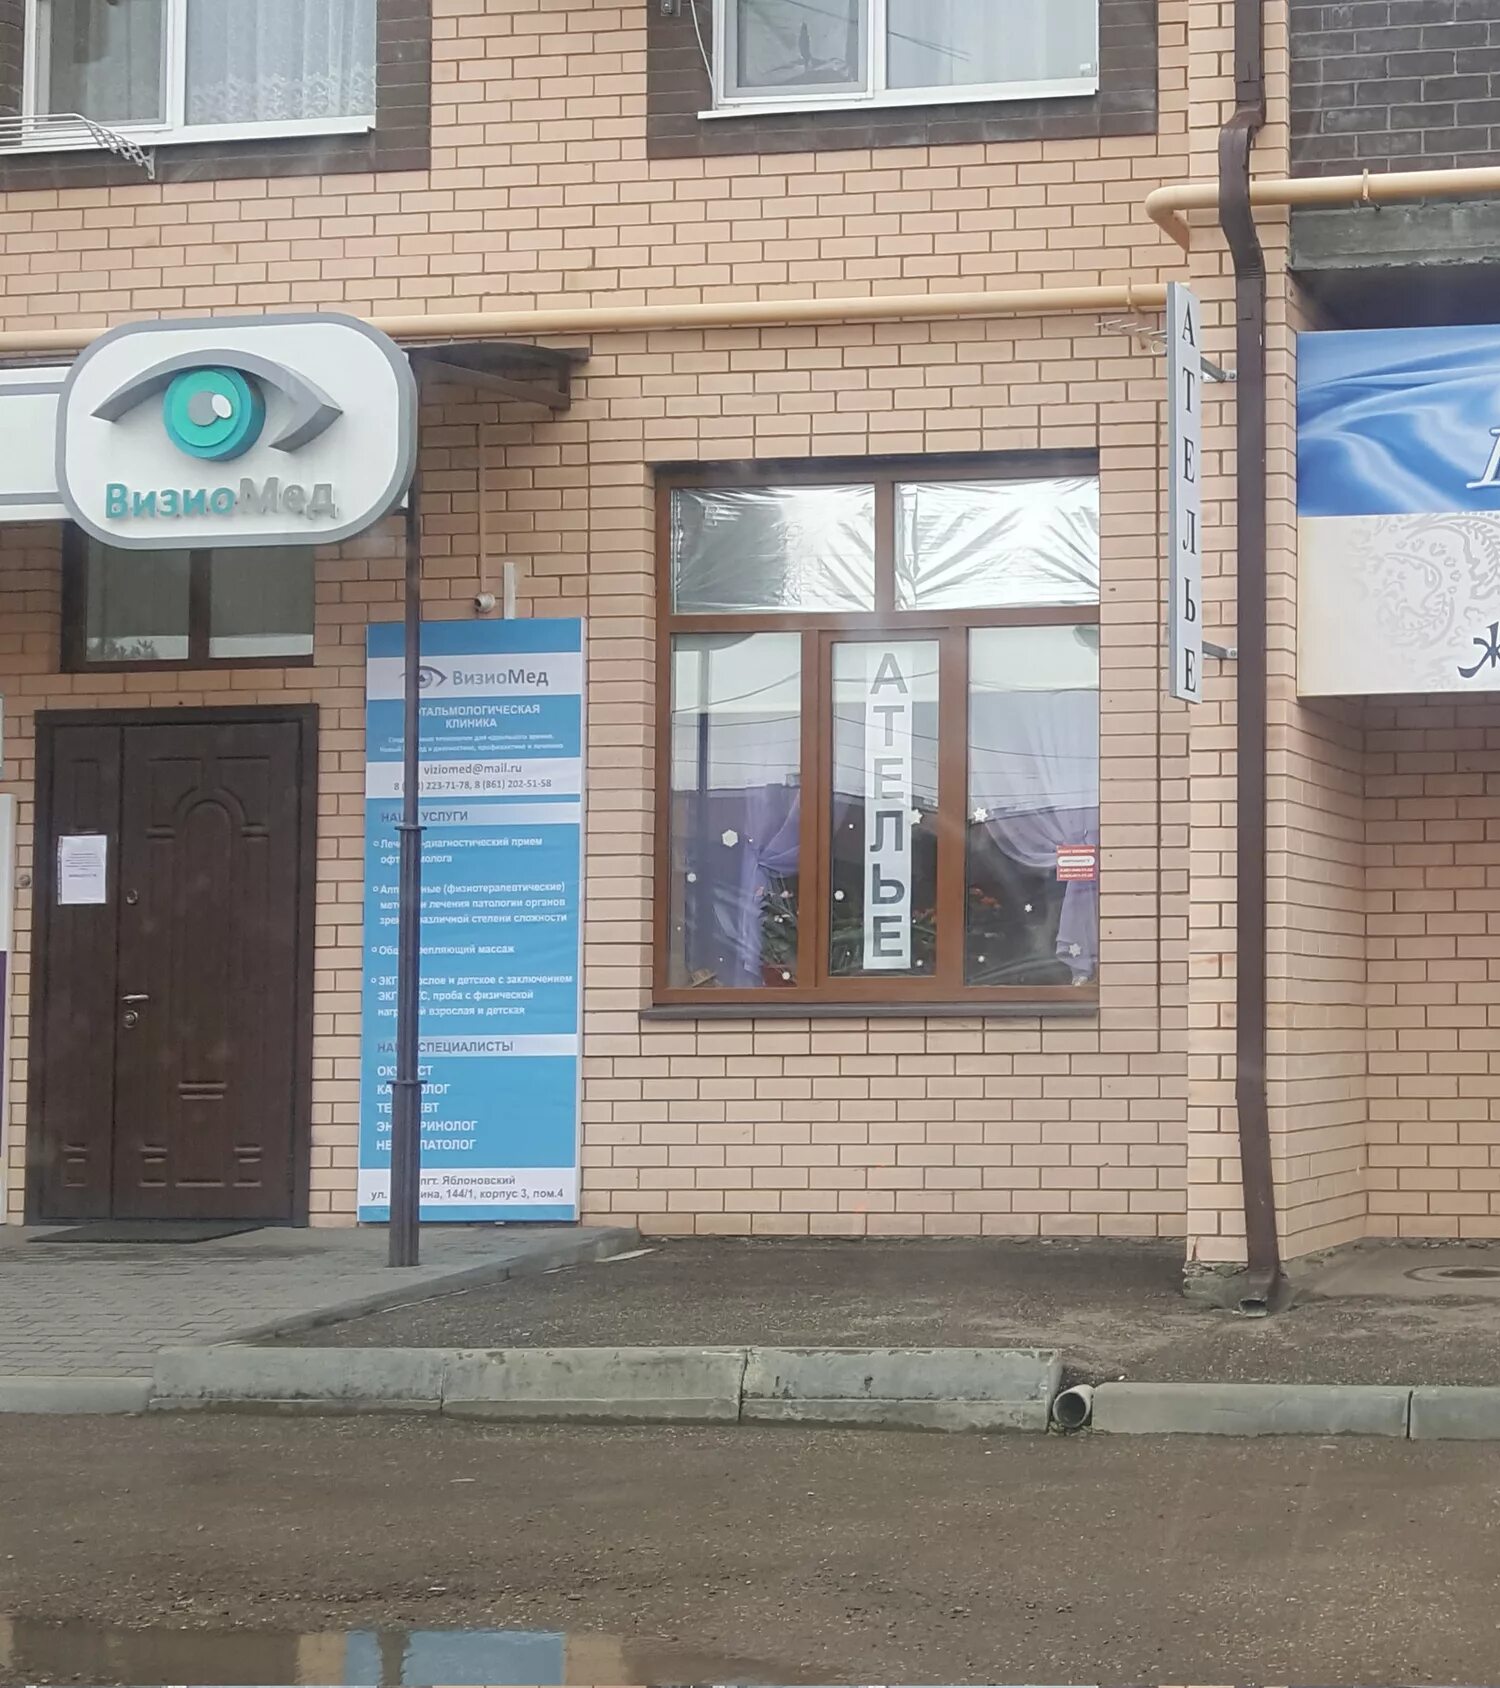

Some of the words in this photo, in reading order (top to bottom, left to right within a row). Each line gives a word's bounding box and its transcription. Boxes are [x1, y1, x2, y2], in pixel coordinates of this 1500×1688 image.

[105, 476, 339, 521] ВизиоМед
[1181, 301, 1197, 693] АТЕЛЬЕ
[452, 669, 549, 687] ВизиоМед
[419, 704, 541, 717] ТАЛЬМОЛОГИЧЕСКАЯ
[445, 718, 498, 729] КЛИНИКА
[424, 763, 523, 776] viziomed@mail.ru
[869, 652, 908, 959] АТЕЛЬЕ
[422, 811, 469, 822] УСЛУГИ
[511, 837, 543, 848] прием
[443, 881, 566, 895] (физиотерапевтические)
[513, 913, 568, 923] сложности
[478, 945, 515, 954] массаж
[457, 977, 497, 986] детское
[506, 975, 573, 985] заключением
[432, 991, 463, 1002] проба
[473, 989, 534, 1001] физической
[429, 1006, 475, 1018] взрослая
[486, 1006, 525, 1016] детская
[418, 1040, 514, 1054] СПЕЦИАЛИСТЫ
[376, 1120, 478, 1132] ЭНРИНОЛОГ
[375, 1139, 477, 1151] НЕПАТОЛОГ
[442, 1175, 516, 1186] Яблоновский
[446, 1189, 477, 1201] 144/1,
[479, 1189, 518, 1201] корпус
